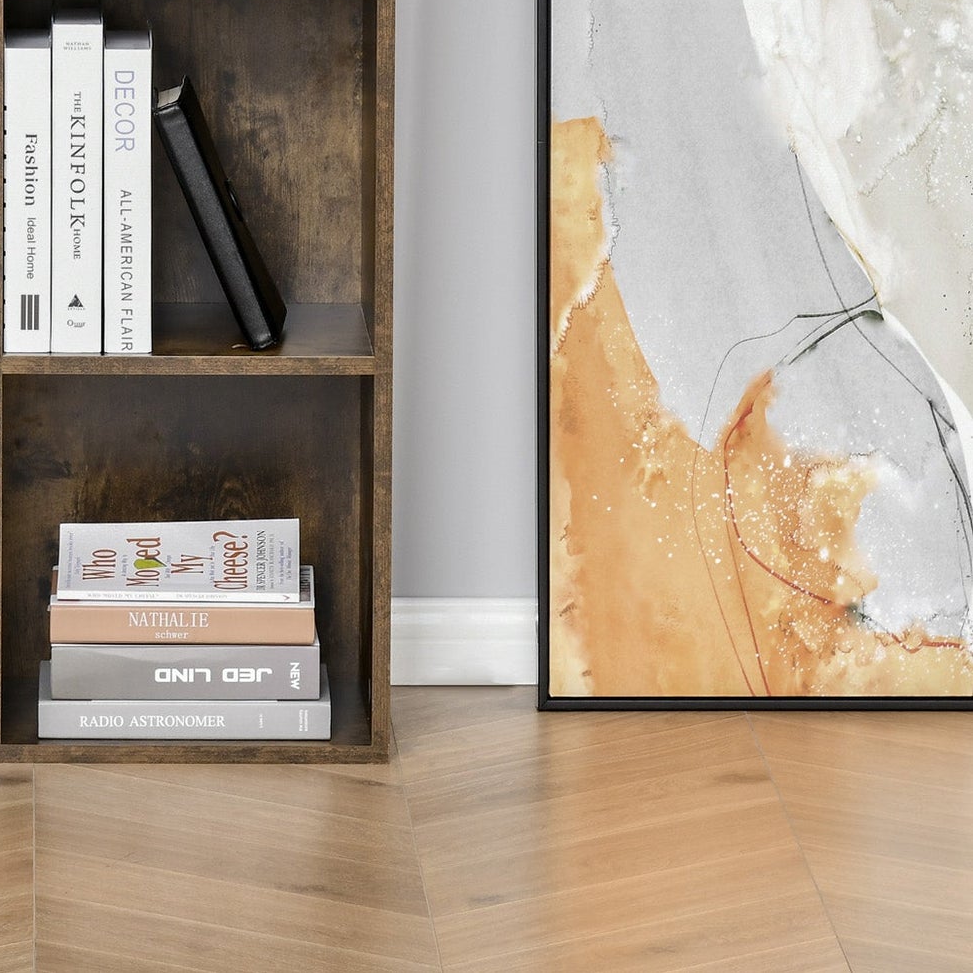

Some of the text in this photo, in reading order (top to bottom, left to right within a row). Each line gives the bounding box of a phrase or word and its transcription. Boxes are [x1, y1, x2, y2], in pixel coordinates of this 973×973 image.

[114, 70, 135, 152] DECOR
[70, 91, 86, 260] THE KINFOLK HOME
[25, 133, 39, 280] Fashion Ideal Home
[120, 189, 133, 352] ALL-AMERICAN FLAIR
[82, 548, 118, 581] Who
[170, 554, 214, 575] My
[212, 530, 249, 591] Cheese?
[129, 611, 209, 627] NATHALIE
[154, 630, 189, 640] schwer
[154, 667, 273, 683] JED LIND
[289, 662, 301, 690] NEW
[79, 715, 226, 728] RADIO ASTRONOMER
